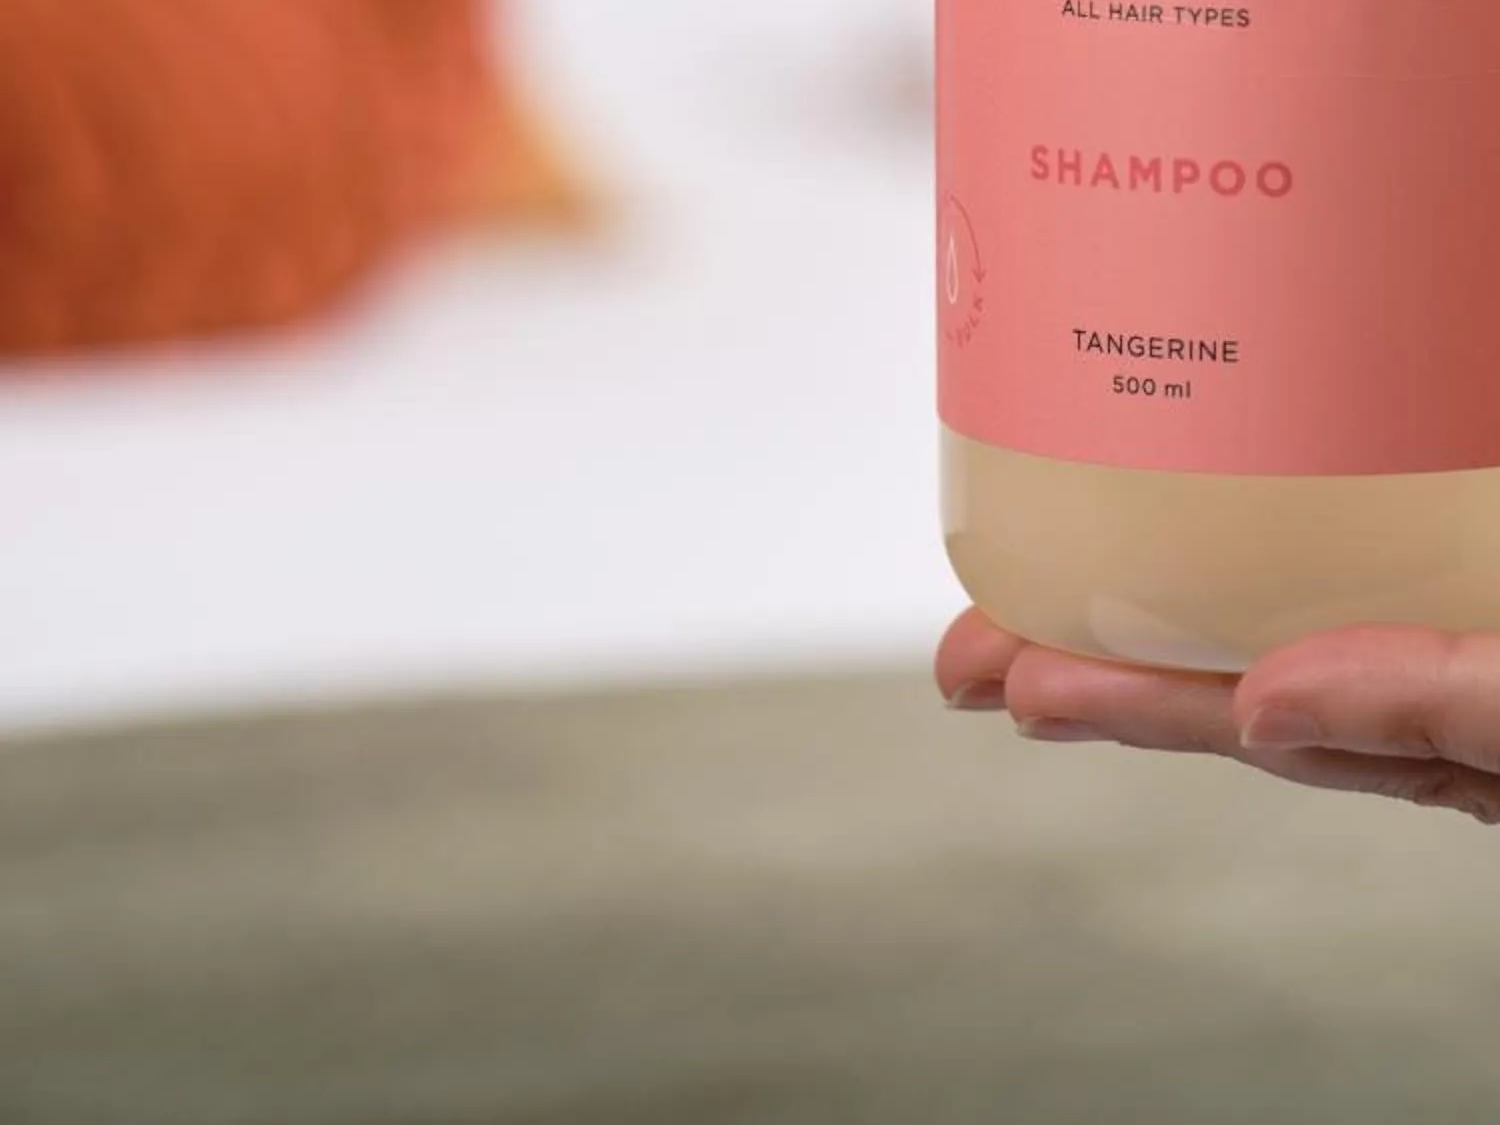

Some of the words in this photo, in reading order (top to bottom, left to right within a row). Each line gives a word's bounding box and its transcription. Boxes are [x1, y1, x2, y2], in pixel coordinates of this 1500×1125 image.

[1109, 3, 1163, 23] HAIR
[1174, 6, 1250, 28] TYPES
[1031, 145, 1293, 198] SHAMPOO
[1073, 329, 1240, 363] TANGERINE
[1112, 375, 1157, 396] 500
[1164, 380, 1191, 398] ml
